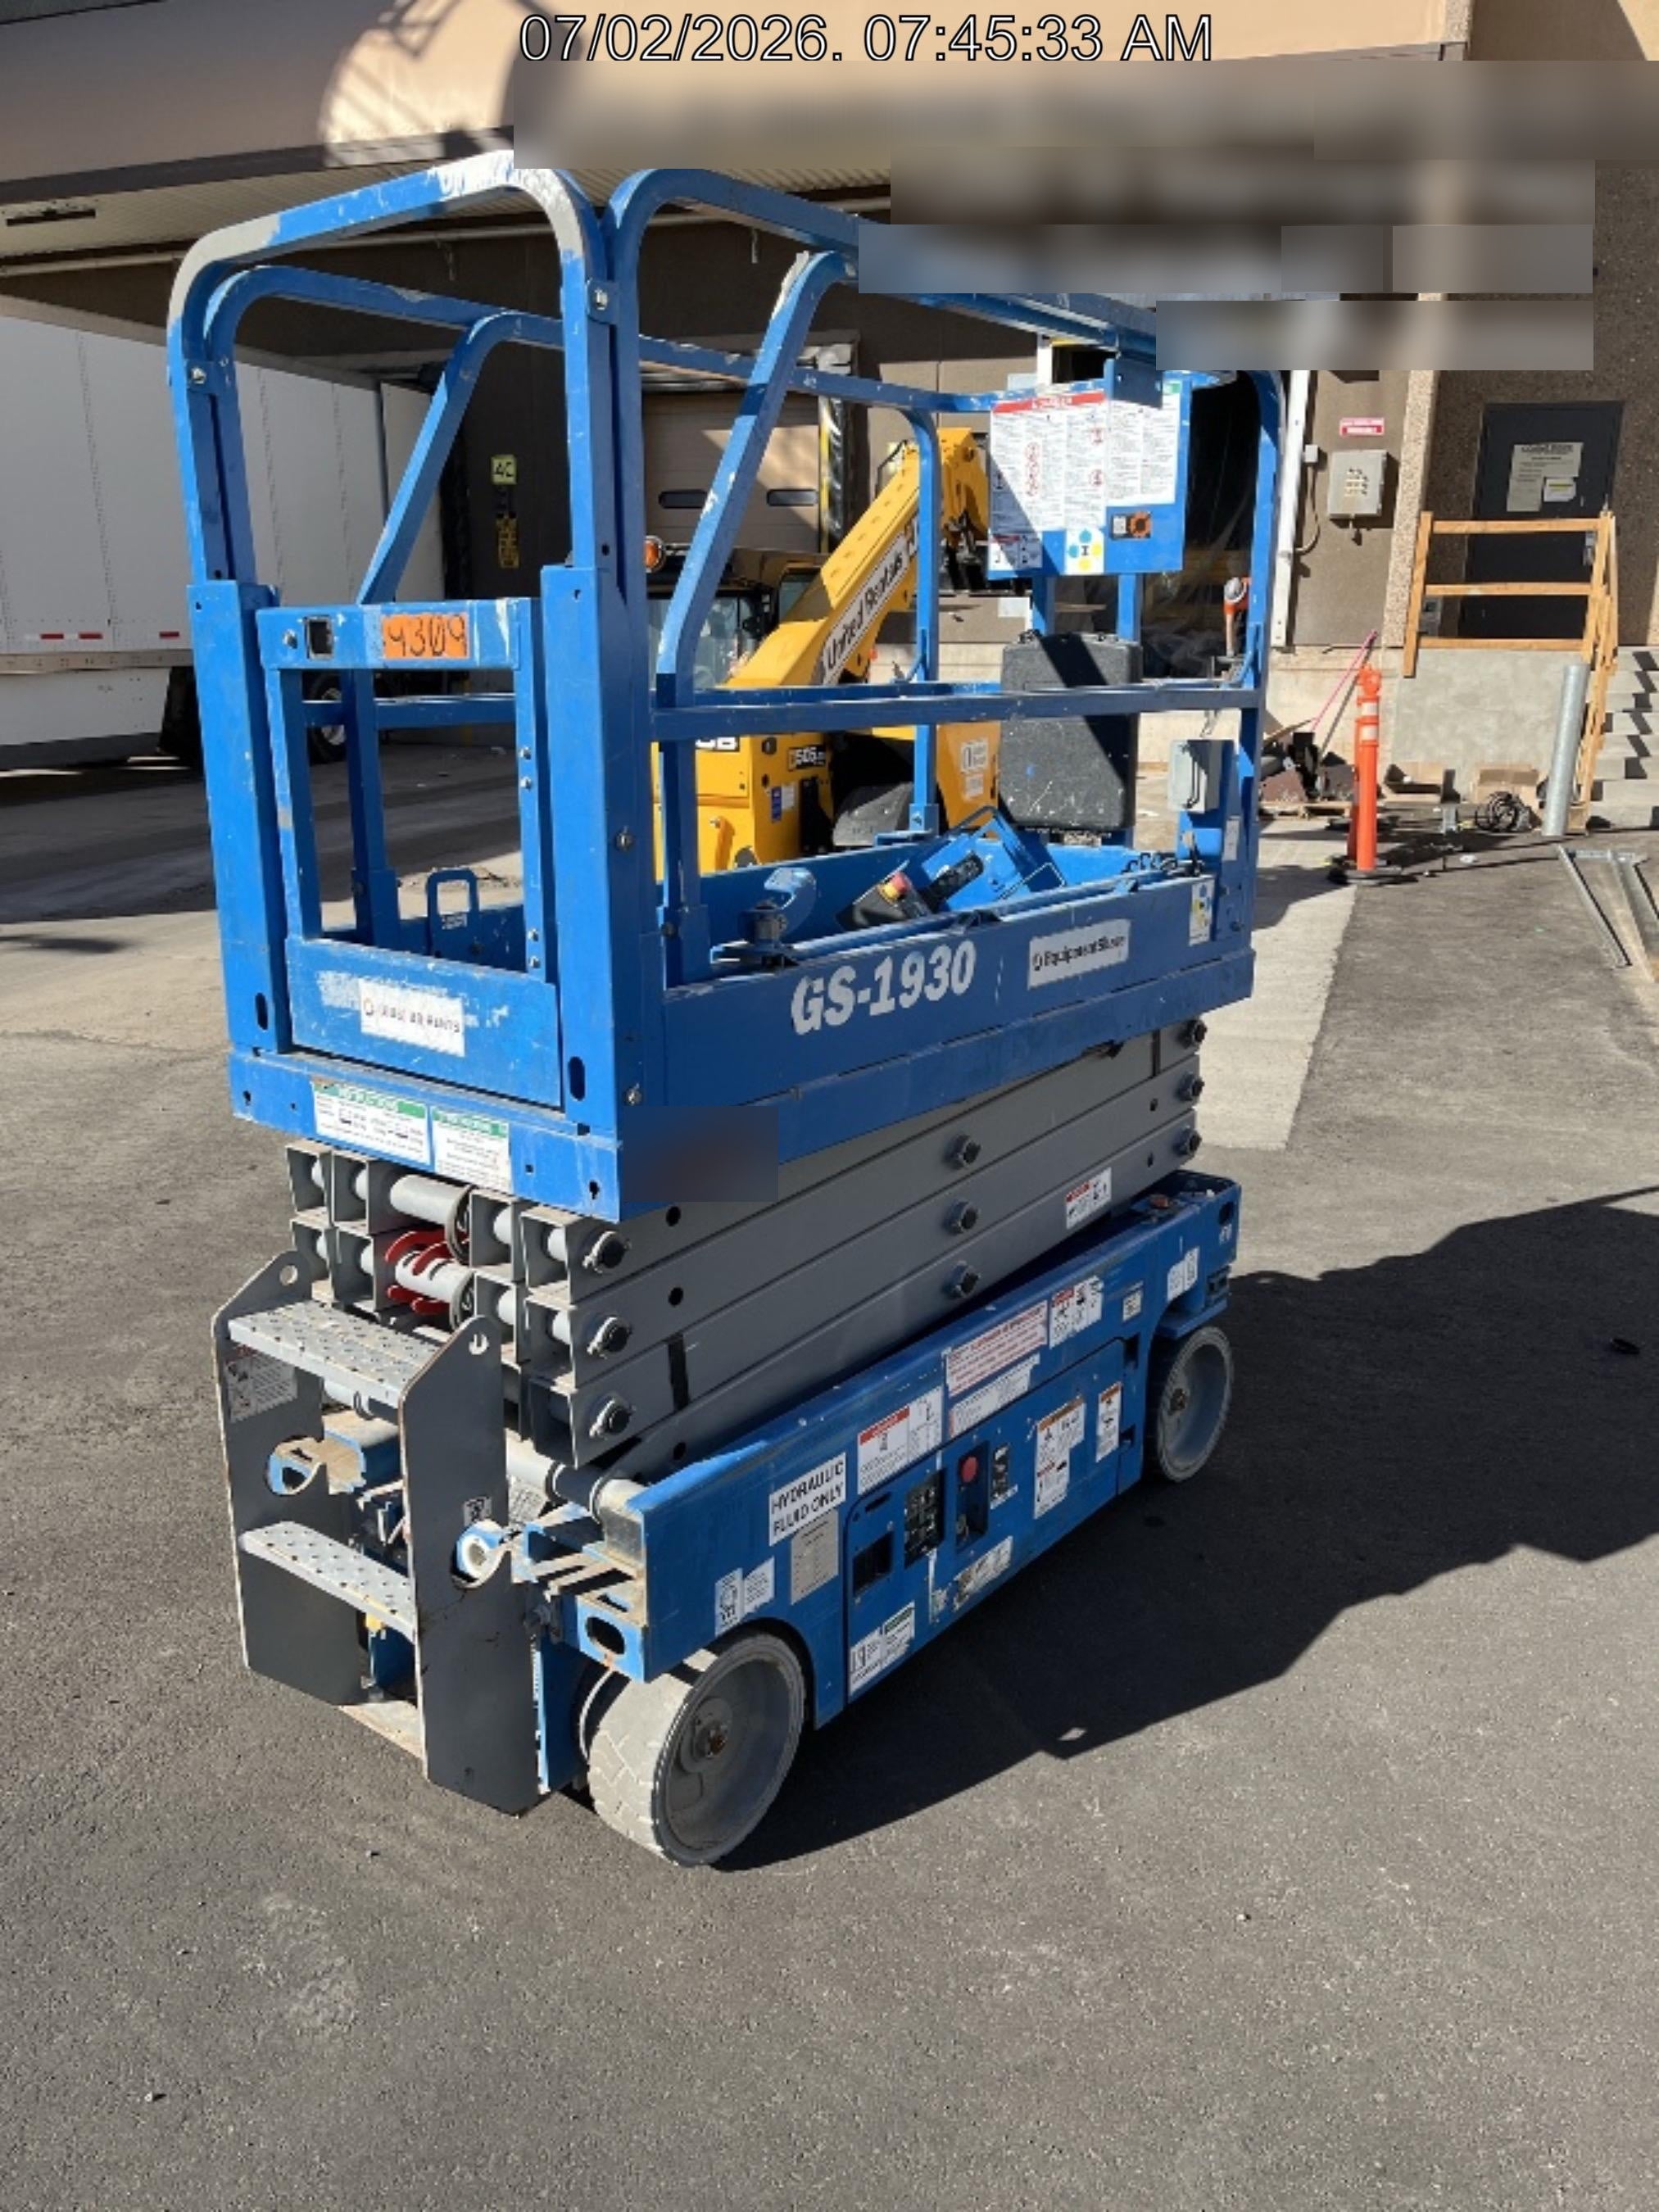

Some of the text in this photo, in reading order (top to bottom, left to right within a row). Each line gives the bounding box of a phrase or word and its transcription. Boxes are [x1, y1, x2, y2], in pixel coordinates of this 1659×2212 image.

[791, 940, 977, 1036] GS-1930
[772, 1460, 844, 1515] HYDRAULIC
[773, 1481, 844, 1537] FLUID ONLY
